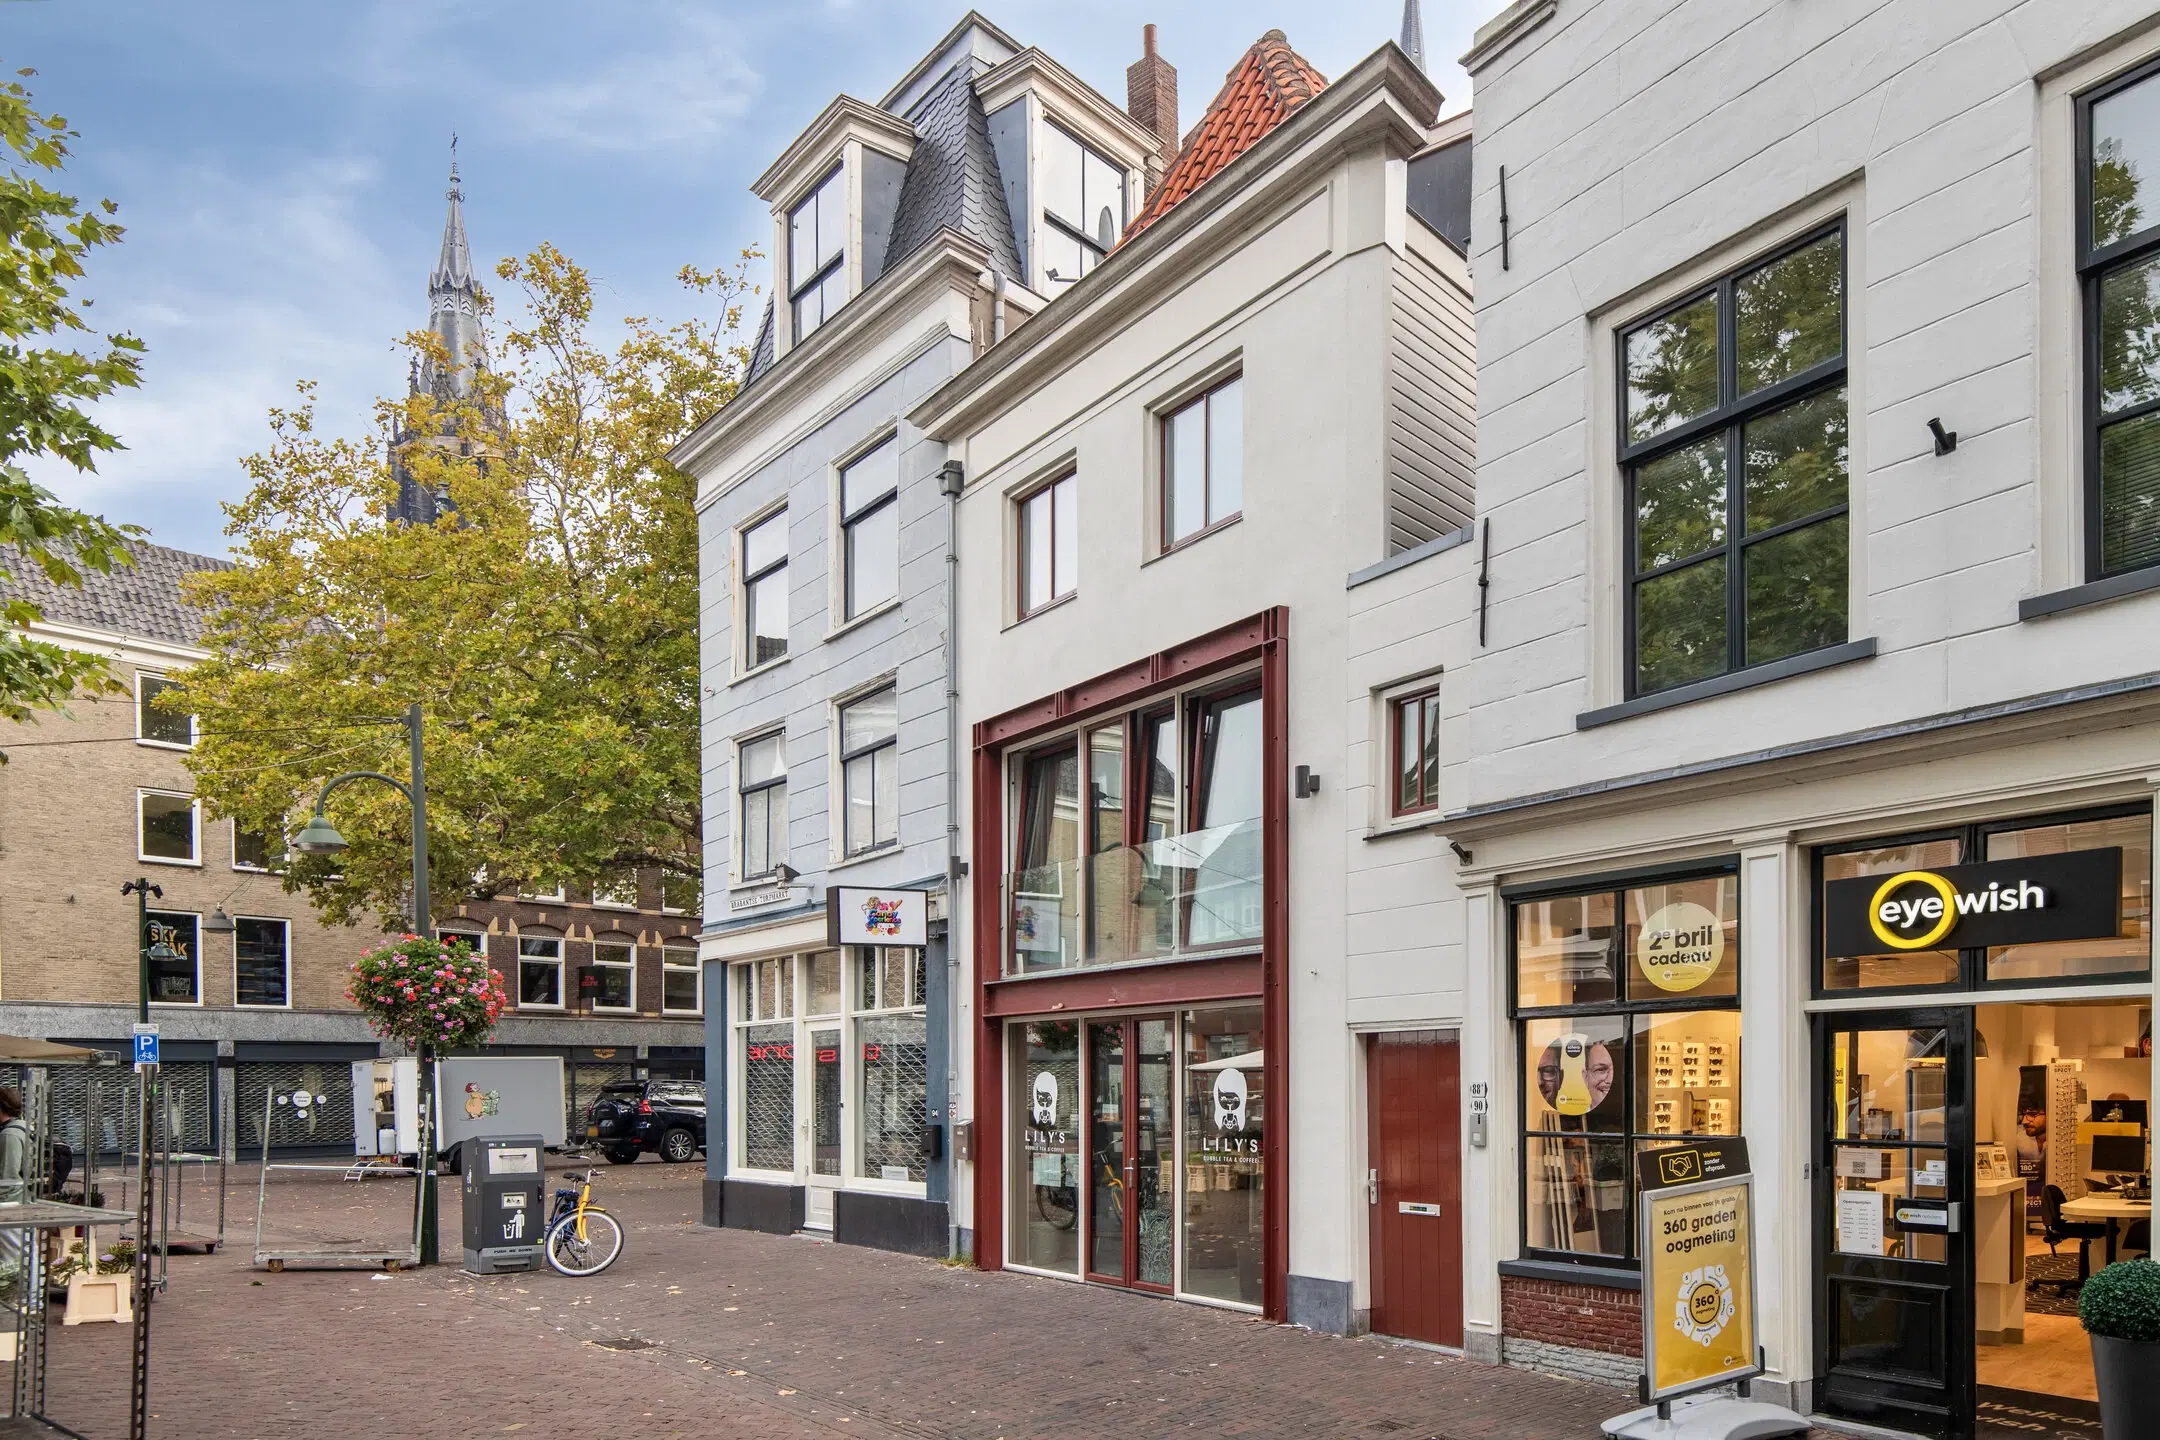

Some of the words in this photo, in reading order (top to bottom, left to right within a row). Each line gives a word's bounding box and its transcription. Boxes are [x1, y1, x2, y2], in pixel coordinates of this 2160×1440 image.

[731, 897, 758, 909] BRABANTSE
[1675, 925, 1713, 949] bril
[1649, 951, 1712, 966] cadeau
[140, 1036, 154, 1051] P
[931, 1109, 939, 1117] 94
[1474, 1100, 1483, 1111] 90
[1025, 1130, 1065, 1144] LILY'S
[1203, 1137, 1258, 1153] LILY'S
[1704, 1158, 1720, 1166] zonder
[1705, 1164, 1726, 1172] afspraak
[1684, 1203, 1702, 1211] binnen
[1714, 1199, 1720, 1207] je
[1721, 1196, 1736, 1205] gratis
[1663, 1218, 1688, 1235] 360
[1691, 1210, 1737, 1232] graden
[1666, 1229, 1736, 1253] oogmeting
